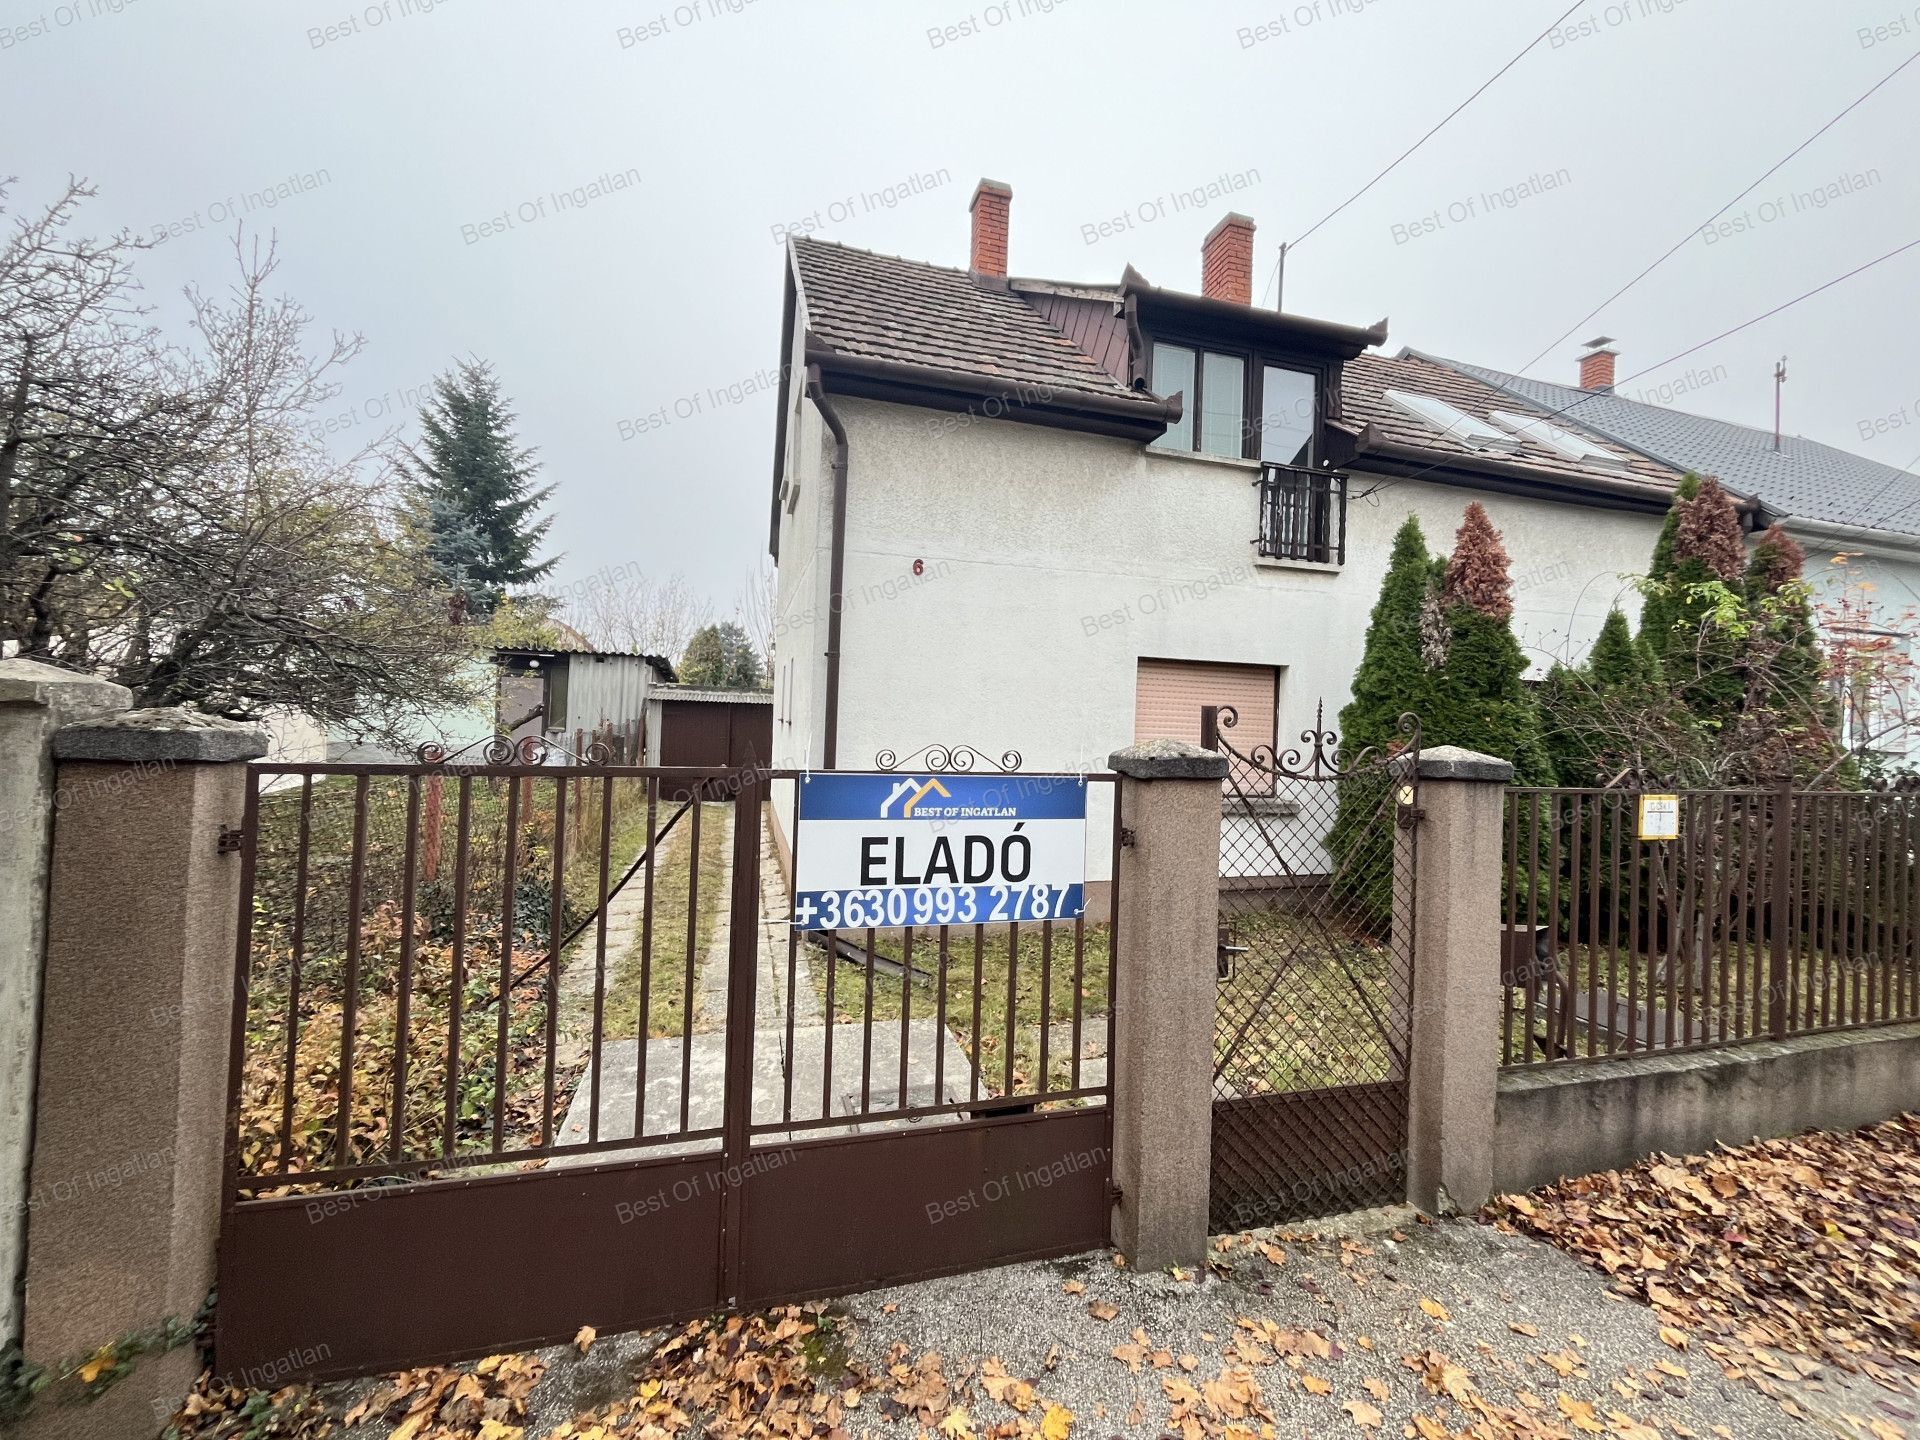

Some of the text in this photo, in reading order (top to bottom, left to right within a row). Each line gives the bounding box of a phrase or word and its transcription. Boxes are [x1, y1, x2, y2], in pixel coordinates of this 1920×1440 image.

[913, 559, 923, 576] 6
[914, 807, 1017, 817] BEST OF INGATLAN
[860, 822, 1031, 886] ELADÓ
[795, 884, 1071, 929] +3630 993 2787
